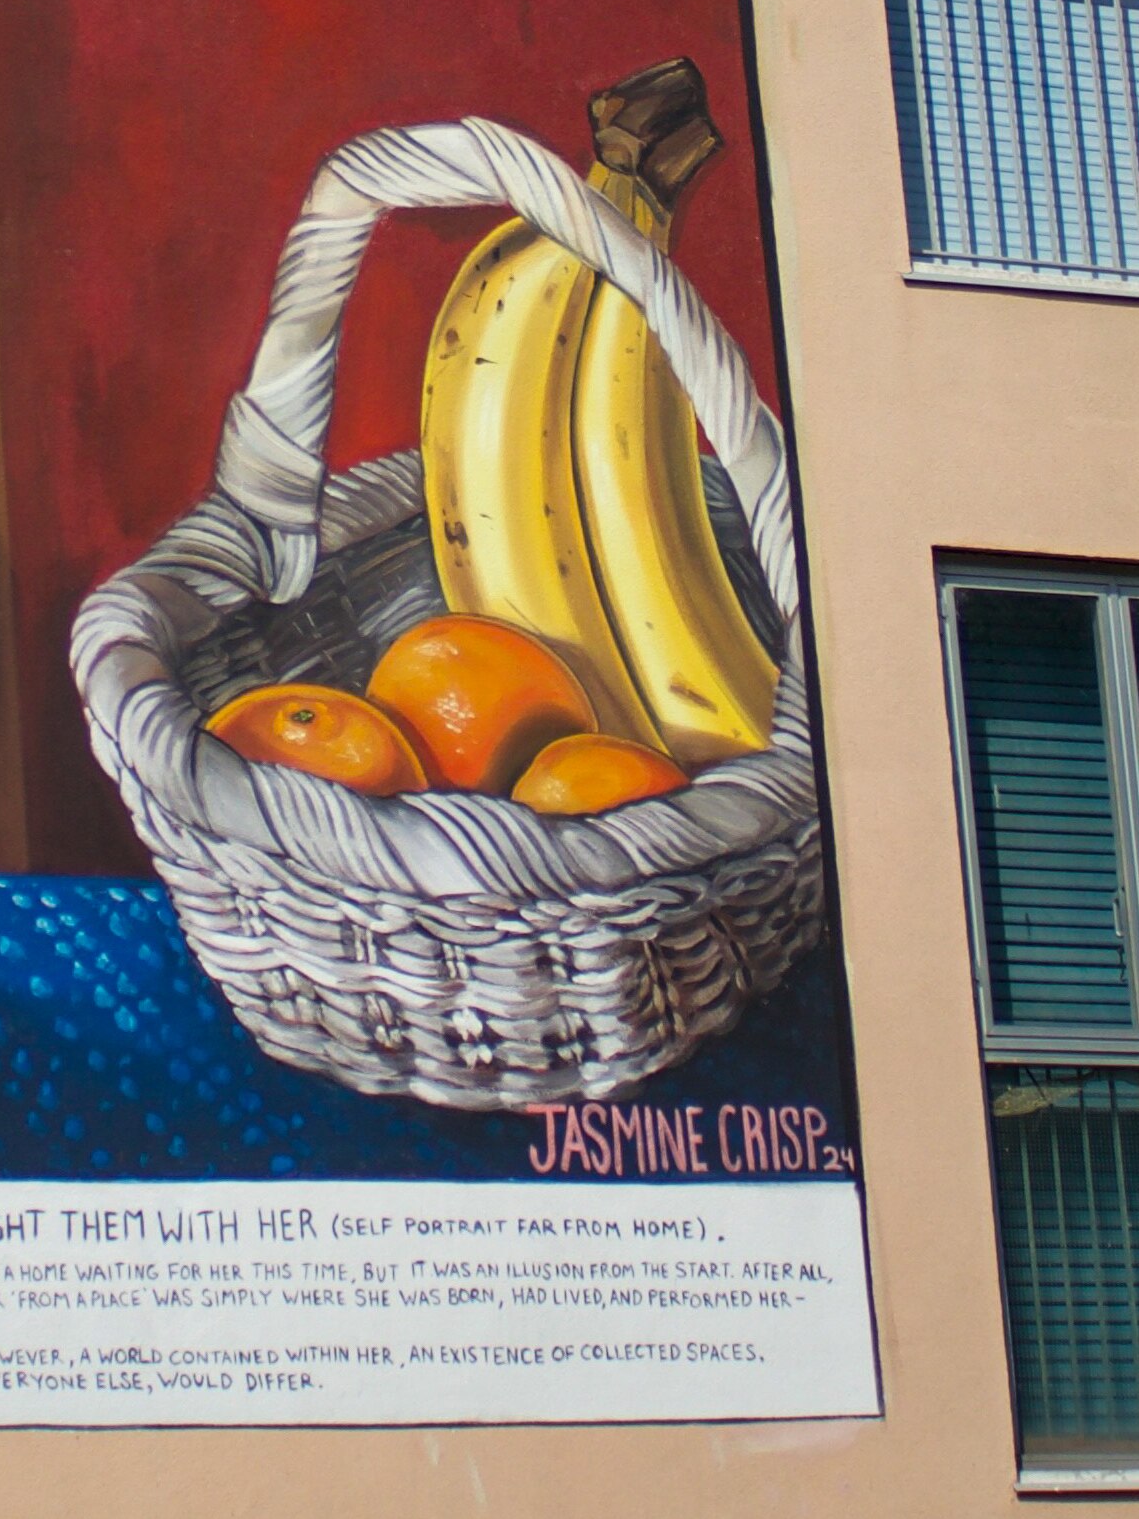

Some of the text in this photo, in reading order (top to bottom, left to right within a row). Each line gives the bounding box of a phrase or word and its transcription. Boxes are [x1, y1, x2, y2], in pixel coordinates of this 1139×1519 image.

[526, 1102, 855, 1175] JASMINE CRISP 24
[59, 1208, 146, 1243] THEM
[156, 1209, 239, 1245] WITH
[257, 1207, 318, 1242] HER
[331, 1212, 392, 1240] (SELF
[404, 1216, 508, 1236] PORTRAIT
[517, 1217, 558, 1236] FAR
[563, 1218, 622, 1239] FROM
[4, 1265, 15, 1281] A
[19, 1262, 67, 1282] HOME
[74, 1261, 159, 1282] WAITING
[167, 1262, 202, 1281] FOR
[209, 1264, 244, 1281] HER
[252, 1262, 293, 1281] THIS
[301, 1262, 356, 1285] TIME,
[363, 1261, 398, 1284] BUT
[411, 1259, 427, 1278] IT
[432, 1261, 472, 1278] WAS
[475, 1263, 500, 1278] AN
[506, 1262, 585, 1281] ILLUSION
[589, 1261, 635, 1280] FROM
[640, 1261, 669, 1280] THE
[674, 1260, 735, 1279] START.
[742, 1261, 794, 1282] AFTER
[799, 1263, 833, 1285] ALL,
[76, 1291, 87, 1308] A
[152, 1287, 194, 1308] WAS
[201, 1287, 272, 1308] SIMPLY
[282, 1288, 345, 1306] WHERE
[354, 1288, 390, 1308] SHE
[398, 1288, 442, 1307] WAS
[447, 1287, 504, 1310] BORN,
[511, 1286, 547, 1305] HAD
[552, 1287, 606, 1310] LIVED,
[609, 1288, 643, 1306] AND
[647, 1288, 753, 1309] PERFORMED
[79, 1347, 92, 1364] A
[97, 1346, 163, 1365] WORLD
[168, 1348, 280, 1366] CONTAINED
[284, 1345, 350, 1363] WITHIN
[409, 1344, 435, 1363] AN
[440, 1345, 545, 1366] EXISTENCE
[550, 1344, 575, 1363] OF
[580, 1343, 682, 1362] COLLECTED
[686, 1341, 765, 1363] SPACES.
[95, 1370, 154, 1395] ELSE,
[156, 1371, 234, 1391] WOULD
[245, 1372, 324, 1393] DIFFER.
